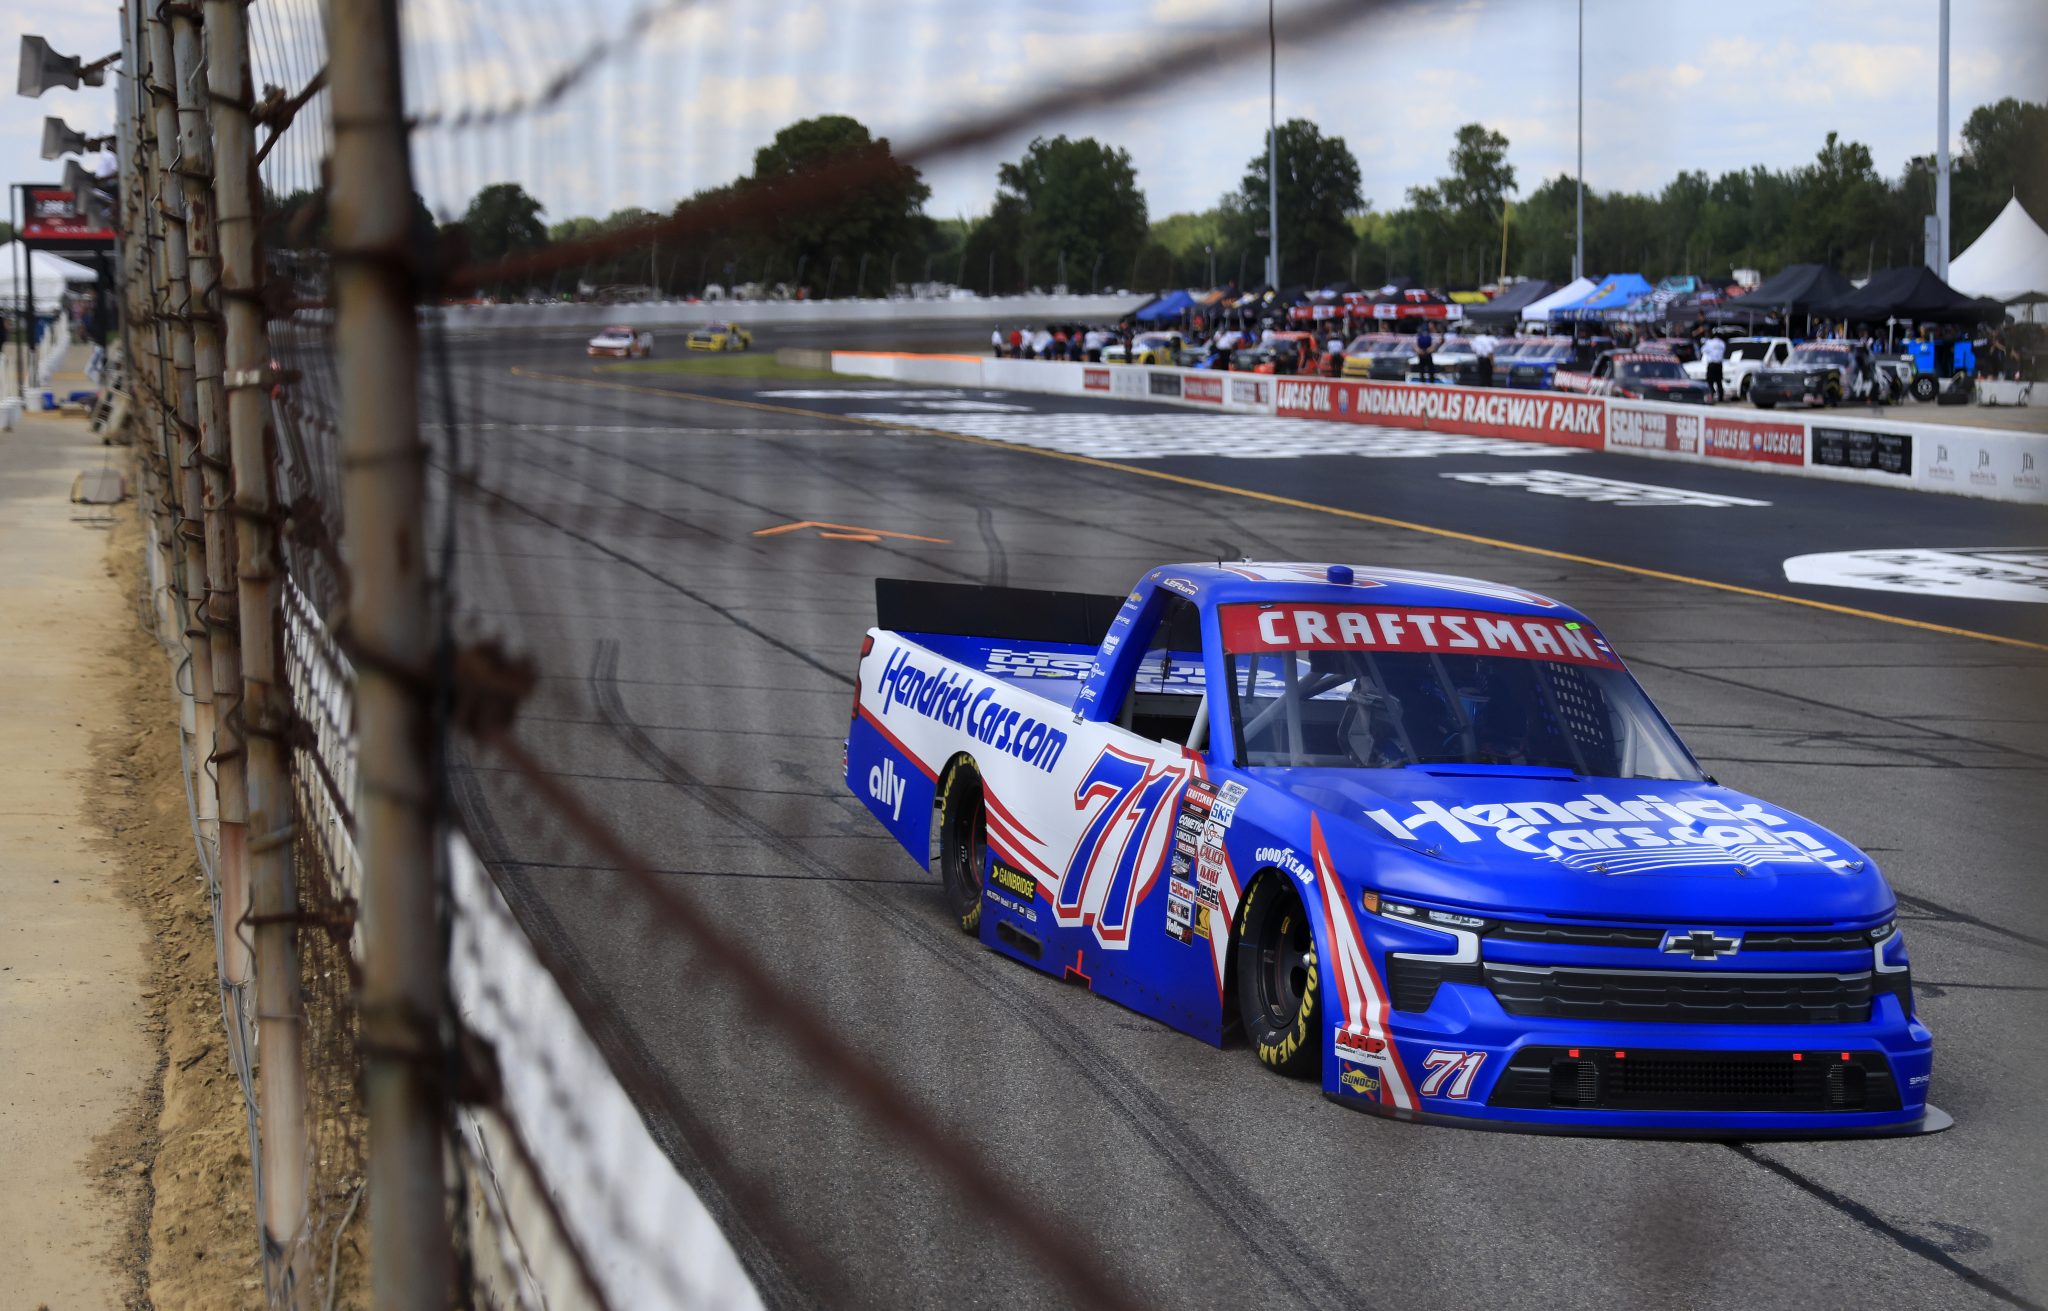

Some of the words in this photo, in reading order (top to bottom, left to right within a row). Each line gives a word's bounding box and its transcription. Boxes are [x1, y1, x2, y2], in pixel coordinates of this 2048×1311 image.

[1277, 382, 1312, 410] LUCAS
[1313, 385, 1330, 411] OIL
[1357, 387, 1462, 421] INDIANAPOLIS
[1463, 396, 1554, 429] RACEWAY
[1550, 402, 1601, 434] PARK
[1714, 428, 1738, 449] LUCAS
[1739, 431, 1750, 451] OIL
[1763, 431, 1788, 455] LUCAS
[1790, 435, 1803, 457] OIL
[1258, 610, 1599, 661] CRAFTSMAN
[869, 758, 907, 822] ally
[1211, 803, 1233, 823] SKF
[1363, 794, 1788, 843] Hendrick
[1055, 743, 1187, 945] 71
[1255, 847, 1315, 885] GOODYEAR
[999, 868, 1035, 899] GAINBRIDGE
[1171, 880, 1194, 901] tilton
[1197, 884, 1220, 905] JESEL
[1336, 1030, 1387, 1054] ARP
[1342, 1074, 1379, 1090] SUNOCO
[1420, 1049, 1488, 1100] 71
